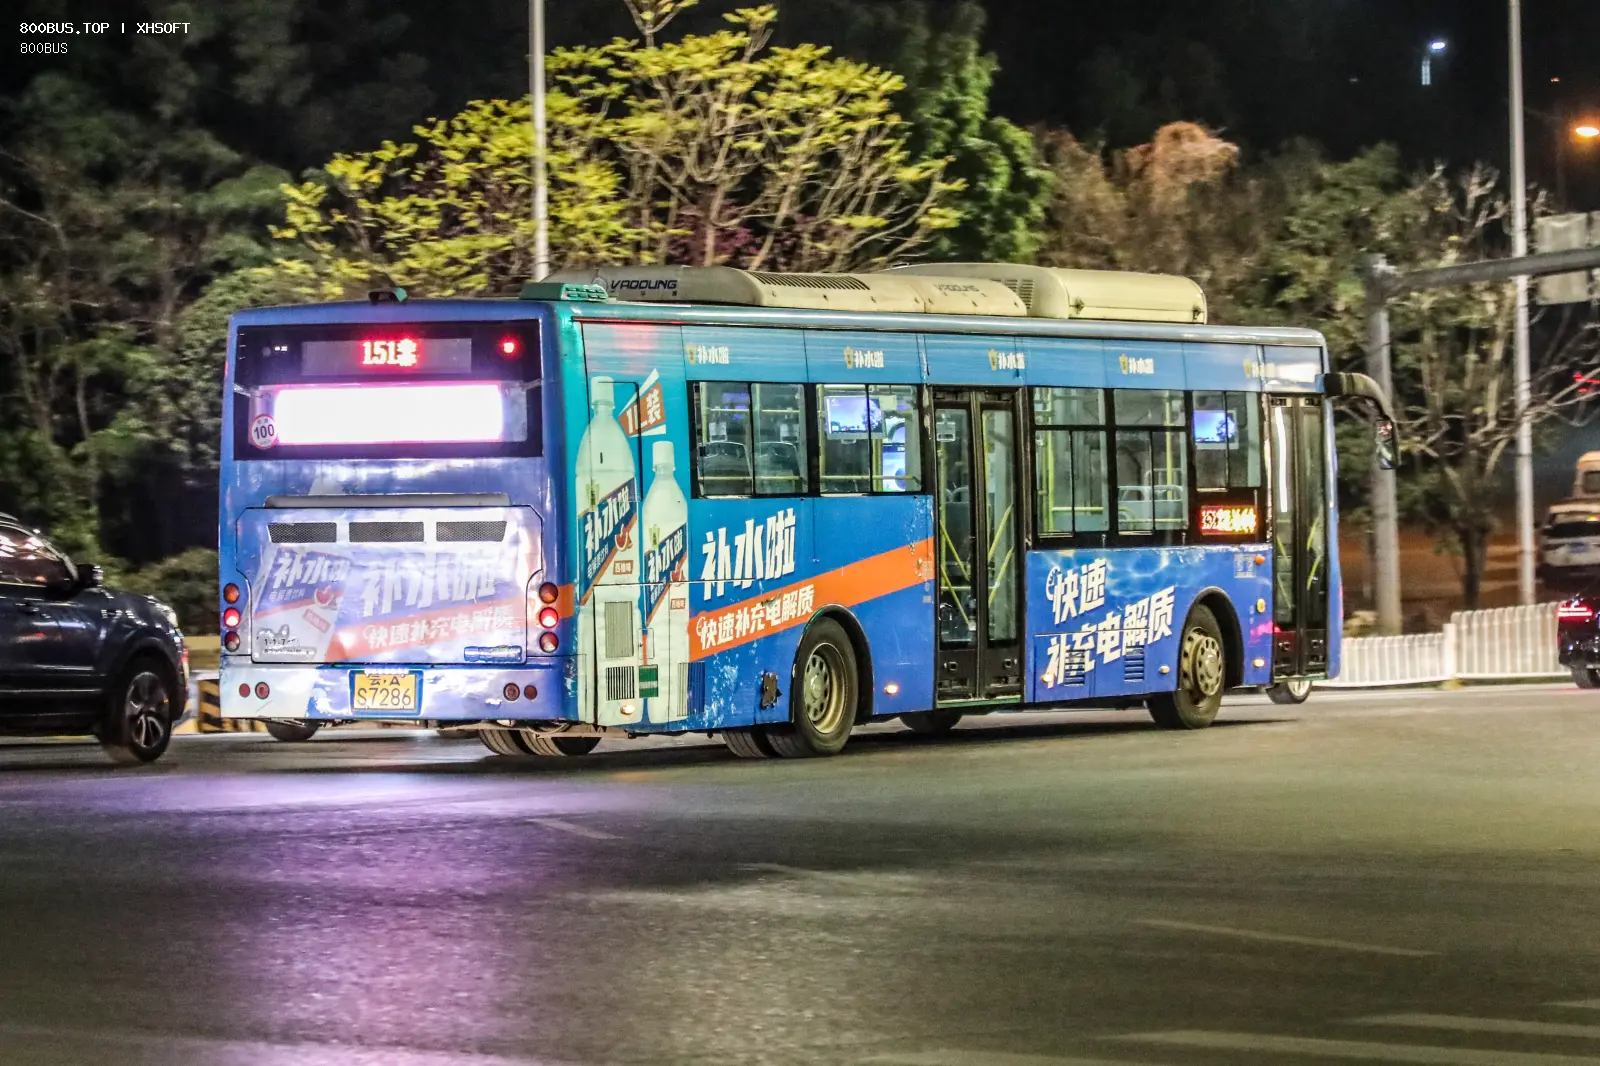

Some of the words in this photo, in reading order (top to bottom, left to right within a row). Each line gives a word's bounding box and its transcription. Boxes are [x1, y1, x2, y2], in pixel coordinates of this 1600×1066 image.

[254, 424, 275, 440] 100
[585, 486, 631, 562] 补水啦
[700, 508, 796, 601] 补水啦
[648, 529, 683, 592] 补水啦
[1050, 557, 1108, 625] 快速
[367, 604, 515, 649] 快速补充电解质
[699, 585, 816, 651] 快速补充电解质
[1046, 585, 1176, 689] 补充电解质
[357, 687, 412, 706] S7286
